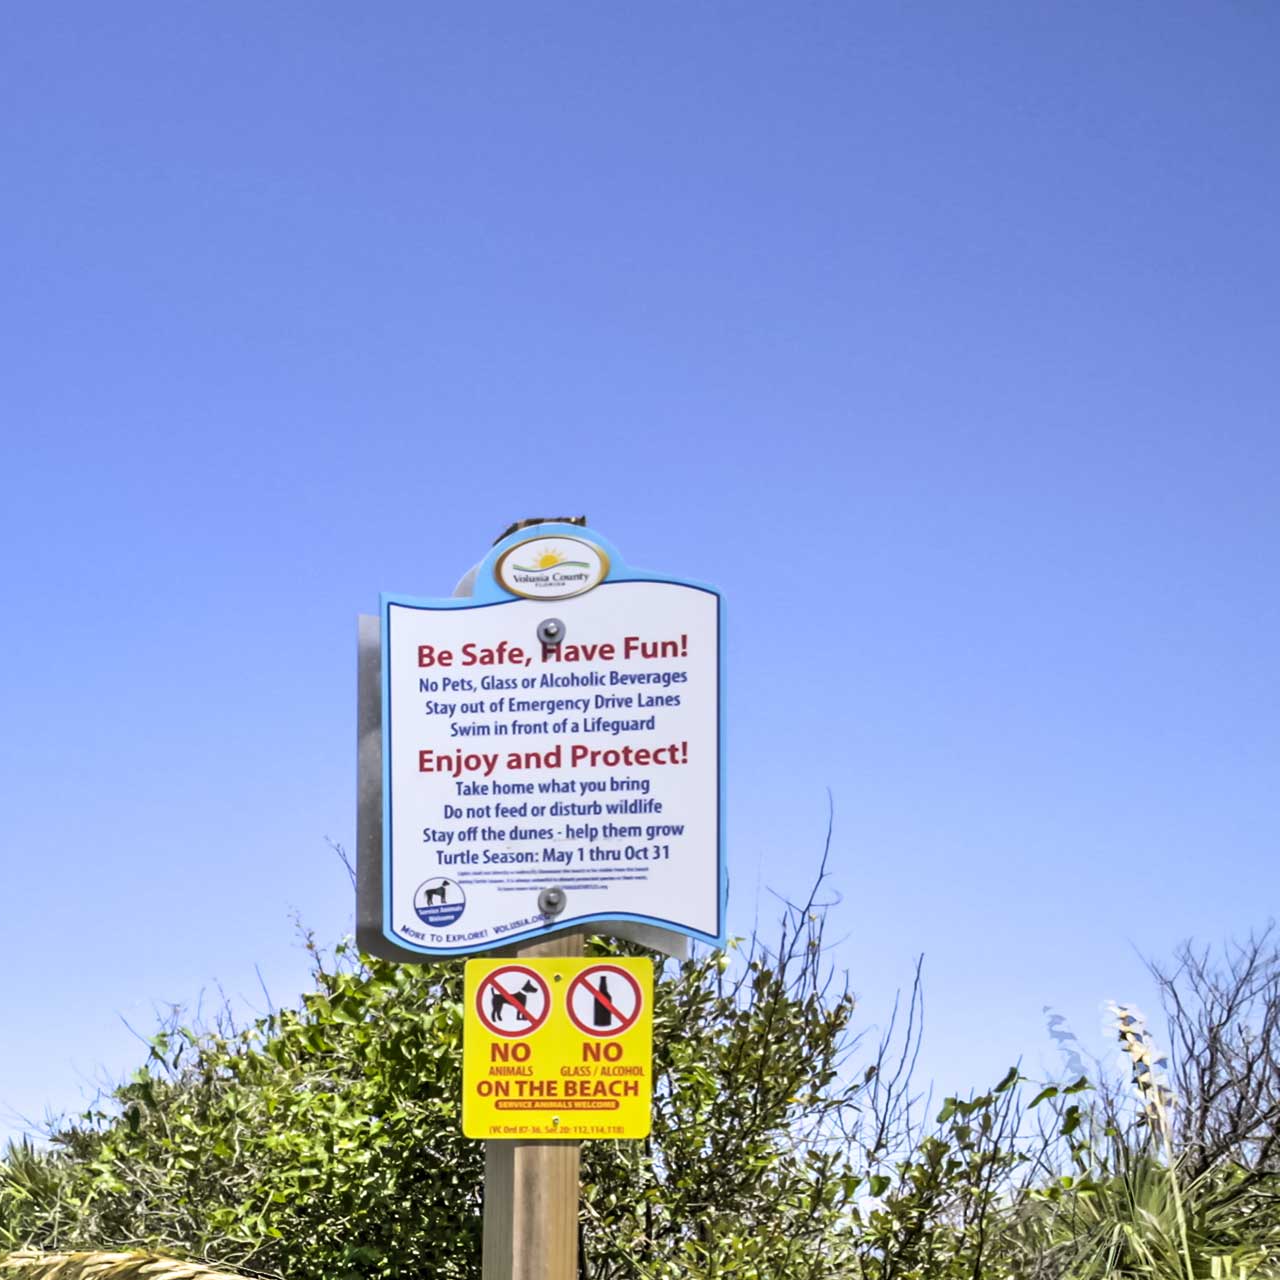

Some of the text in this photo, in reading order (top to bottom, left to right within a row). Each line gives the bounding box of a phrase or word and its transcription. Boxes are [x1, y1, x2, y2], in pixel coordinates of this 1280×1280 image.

[513, 572, 589, 584] Volusia County
[418, 634, 688, 667] Be Safe, Have Fun!
[419, 671, 688, 693] No Pets, Glass or Alcoholic Beverages
[425, 692, 681, 718] Stay out of Emergency Drive Lanes
[450, 715, 655, 737] Swim in front of a Lifeguard
[418, 741, 688, 778] Enjoy and Protect!
[455, 776, 650, 796] Take home what you bring
[444, 798, 662, 819] Do not feed or disturb wildlife
[423, 828, 454, 846] Stay
[457, 826, 478, 841] off
[481, 826, 506, 841] the
[509, 825, 554, 841] dunes
[566, 823, 599, 842] help
[602, 822, 642, 838] them
[646, 824, 684, 841] grow
[436, 845, 669, 866] Turtle Season: May 1 thru Oct 31
[400, 924, 426, 941] MORE
[429, 933, 444, 943] TO
[446, 930, 489, 943] EXPLORE!
[490, 1042, 532, 1063] NO
[582, 1042, 623, 1062] NO
[489, 1066, 533, 1077] ANIMALS
[560, 1066, 591, 1077] GLASS
[600, 1066, 645, 1077] ALCOHOL
[476, 1080, 640, 1097] ON THE BEACH
[498, 1101, 616, 1109] SERVICE ANIMALS WELCOME
